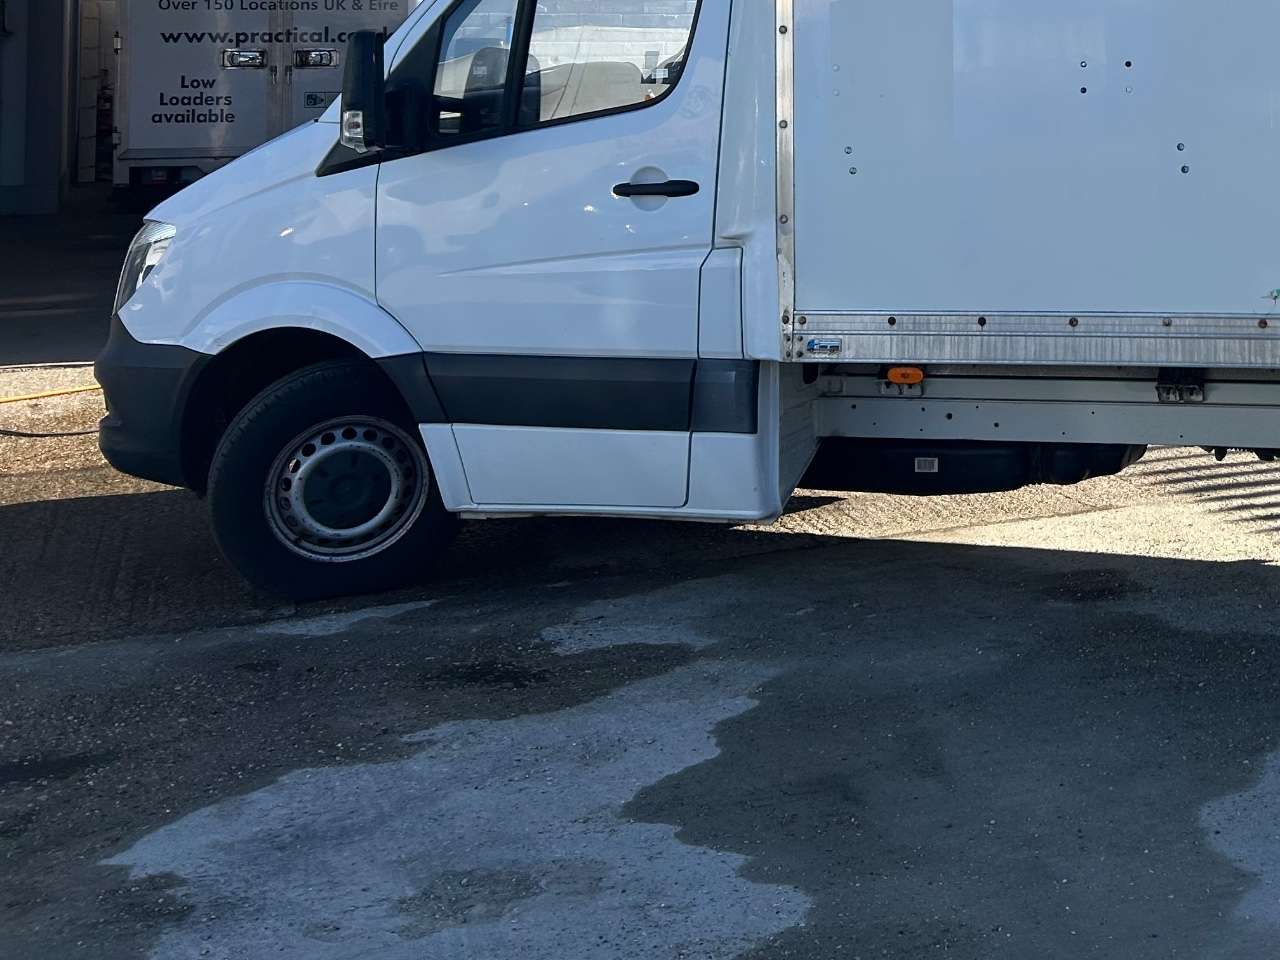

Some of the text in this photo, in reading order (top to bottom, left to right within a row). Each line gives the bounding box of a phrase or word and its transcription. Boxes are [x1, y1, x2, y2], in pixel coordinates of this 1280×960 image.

[180, 74, 217, 90] Low
[159, 91, 233, 107] Loaders
[151, 108, 236, 125] available
